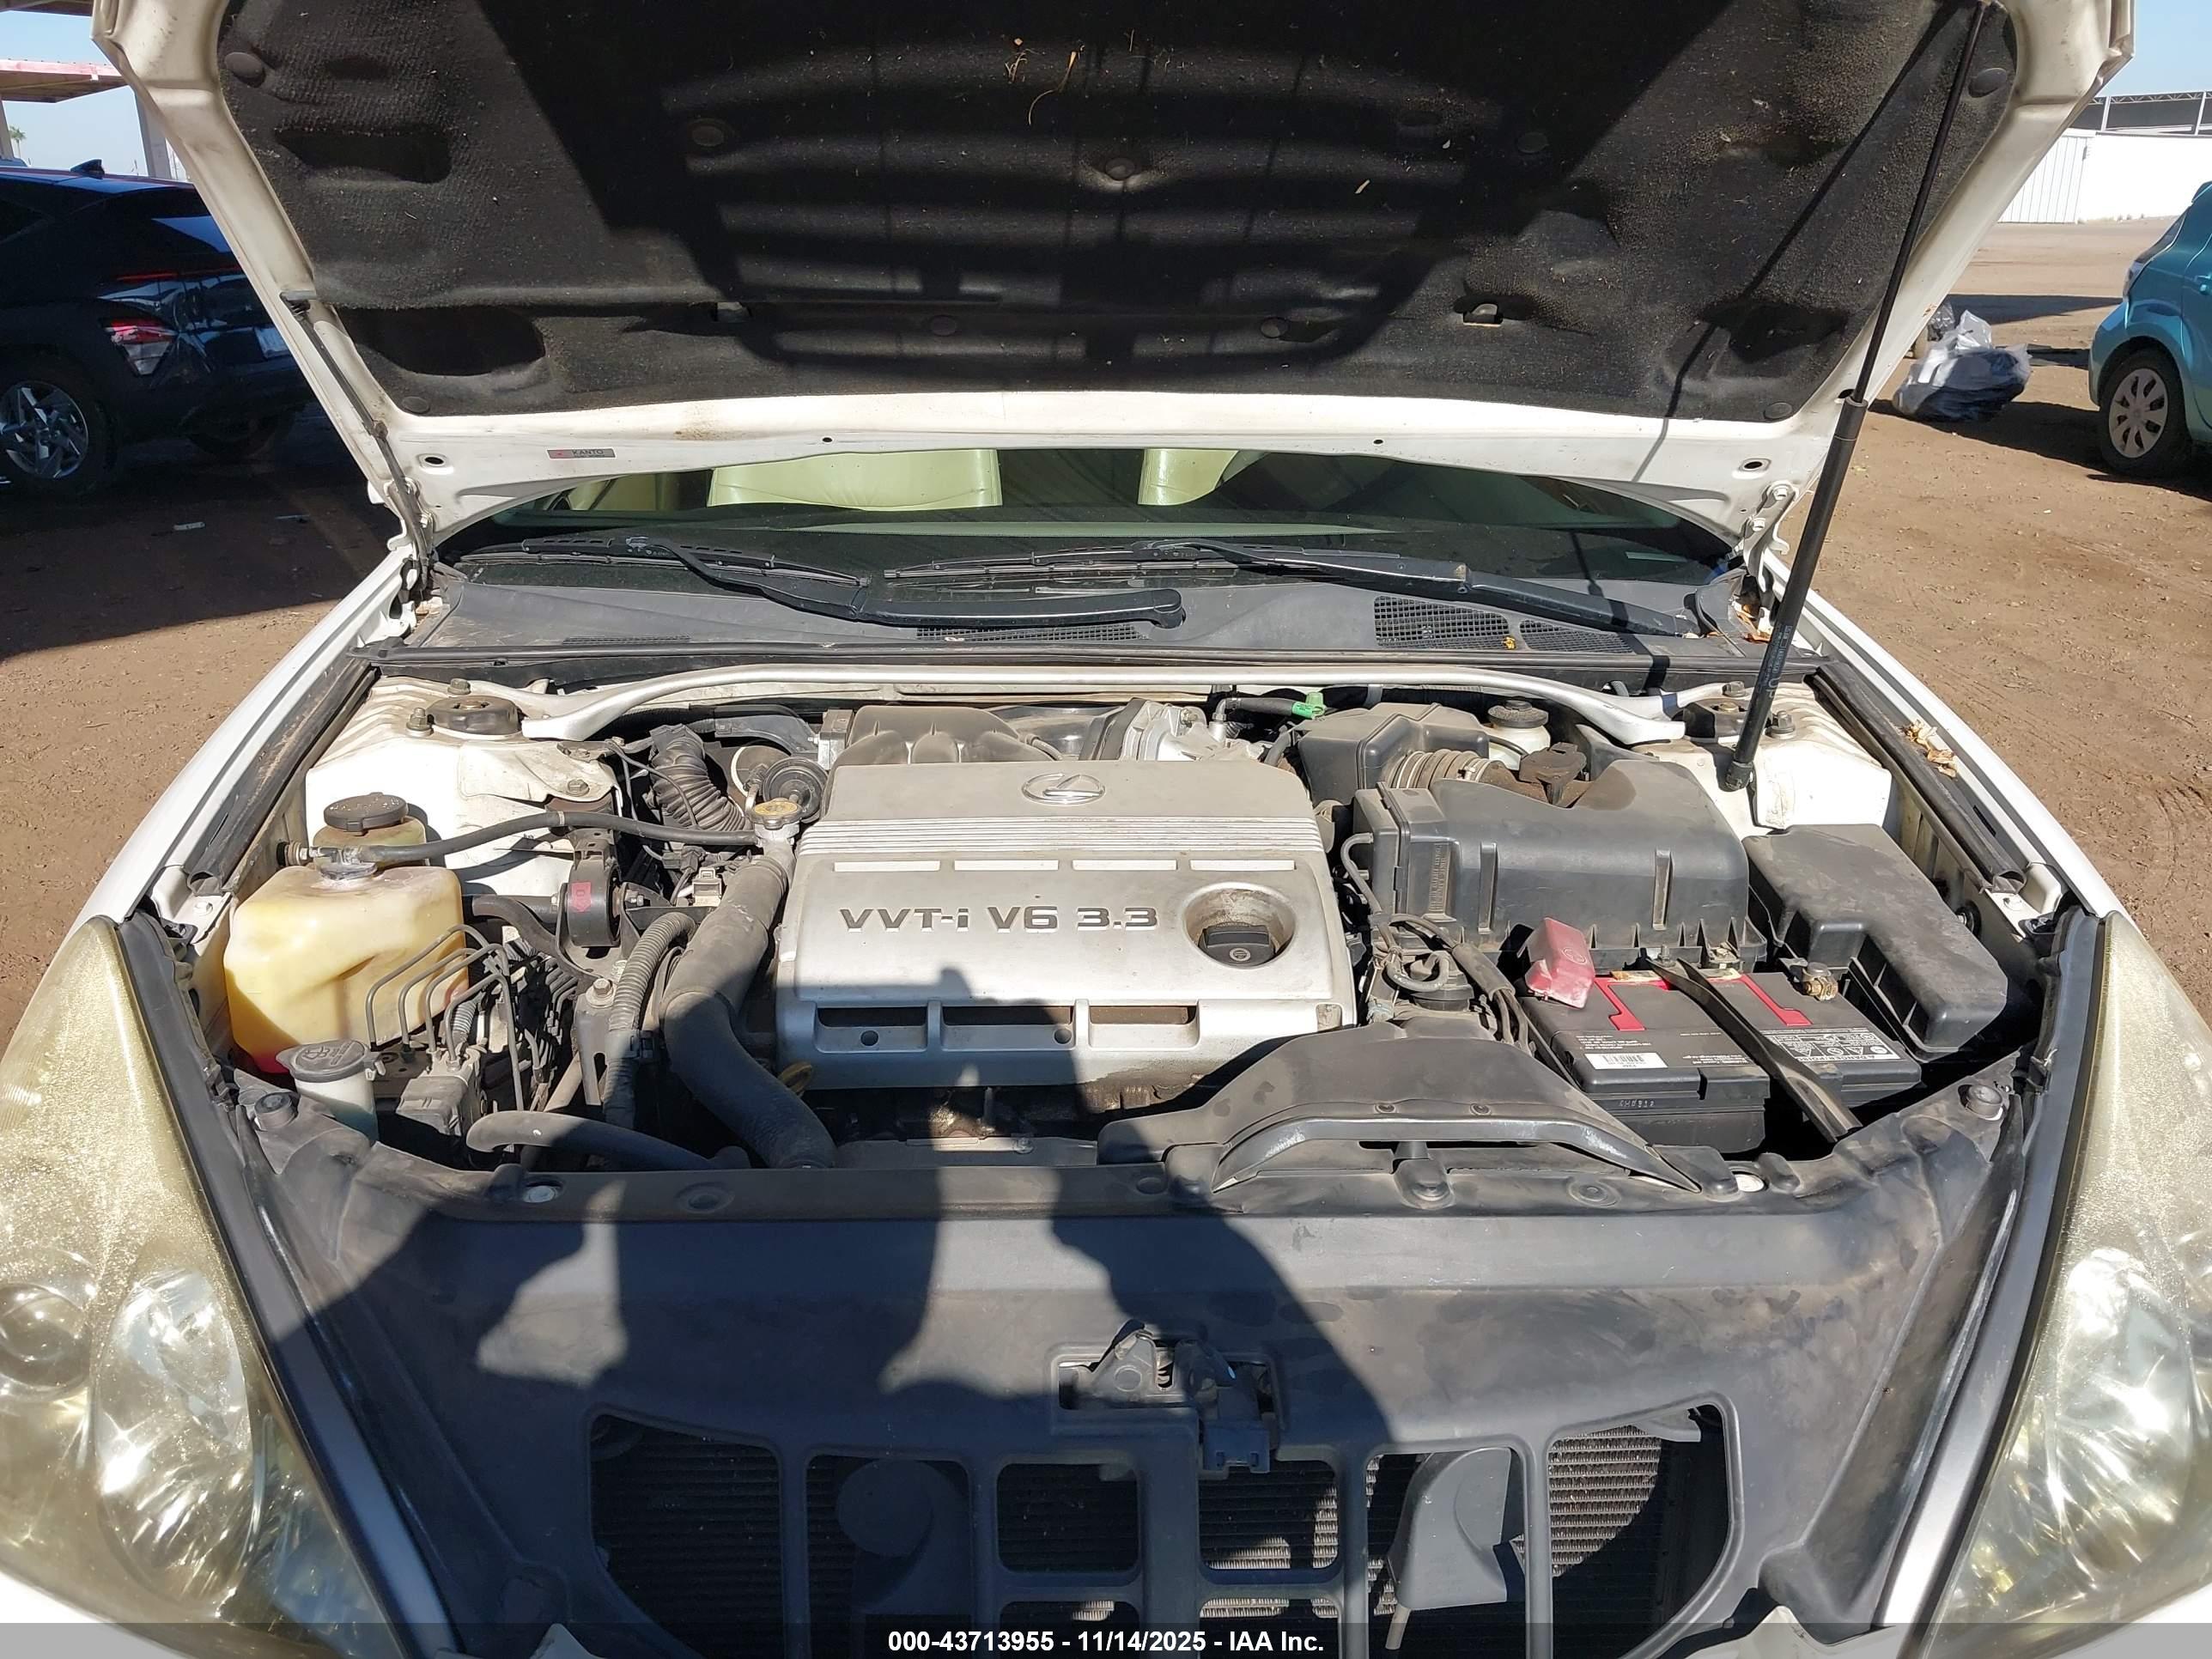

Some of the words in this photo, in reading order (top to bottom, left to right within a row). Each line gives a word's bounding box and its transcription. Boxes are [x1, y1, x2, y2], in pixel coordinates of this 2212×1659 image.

[840, 908, 969, 933] VVT-i
[988, 906, 1059, 933] V6
[1077, 907, 1158, 932] 3.3
